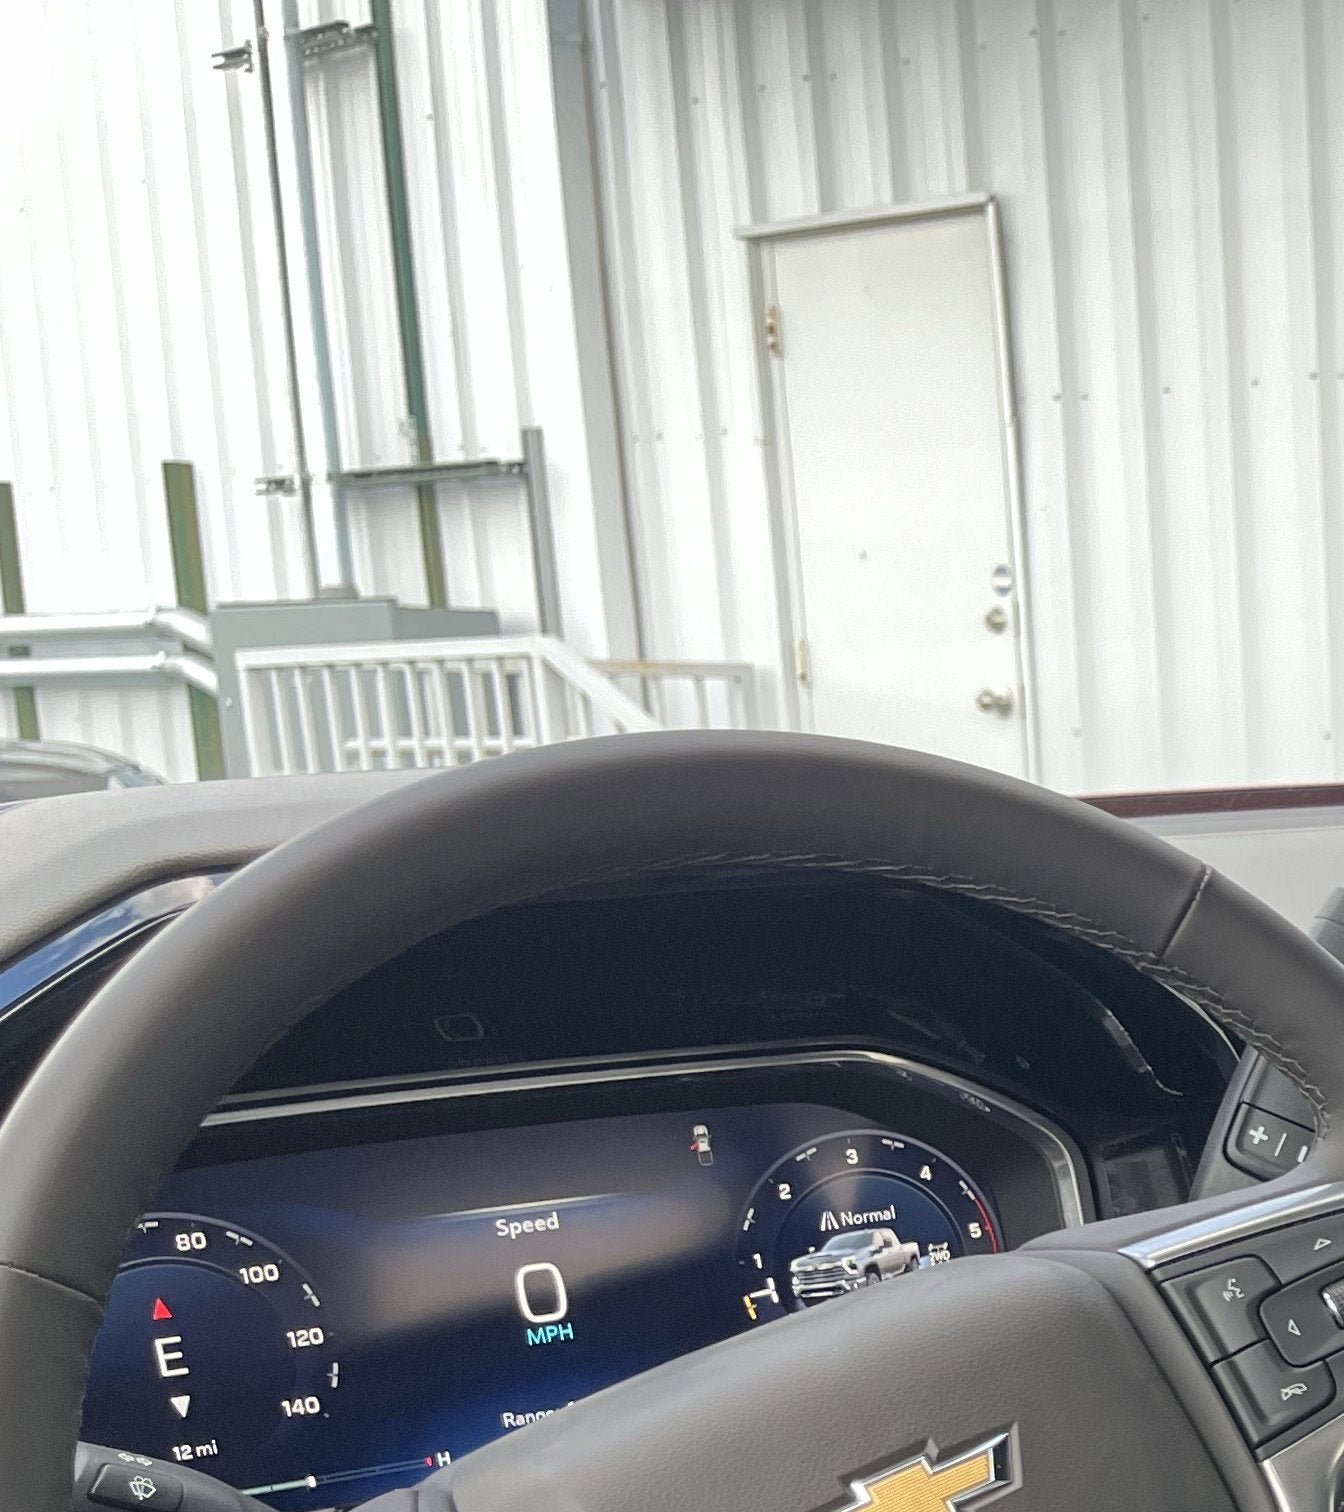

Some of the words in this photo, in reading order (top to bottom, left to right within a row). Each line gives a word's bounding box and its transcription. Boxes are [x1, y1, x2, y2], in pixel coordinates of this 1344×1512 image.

[846, 1148, 859, 1165] 3
[919, 1165, 932, 1181] 4
[778, 1183, 792, 1200] 2
[496, 1211, 559, 1239] Speed
[841, 1205, 896, 1227] Normal
[175, 1231, 206, 1251] 80
[968, 1222, 982, 1239] 5
[752, 1253, 763, 1270] 1
[239, 1263, 280, 1284] 100
[515, 1262, 567, 1323] 0
[286, 1327, 324, 1348] 120
[526, 1322, 574, 1346] MPH
[155, 1336, 190, 1377] E
[281, 1396, 320, 1417] 140
[172, 1444, 194, 1461] 12
[196, 1439, 218, 1456] mi
[436, 1451, 451, 1467] H
